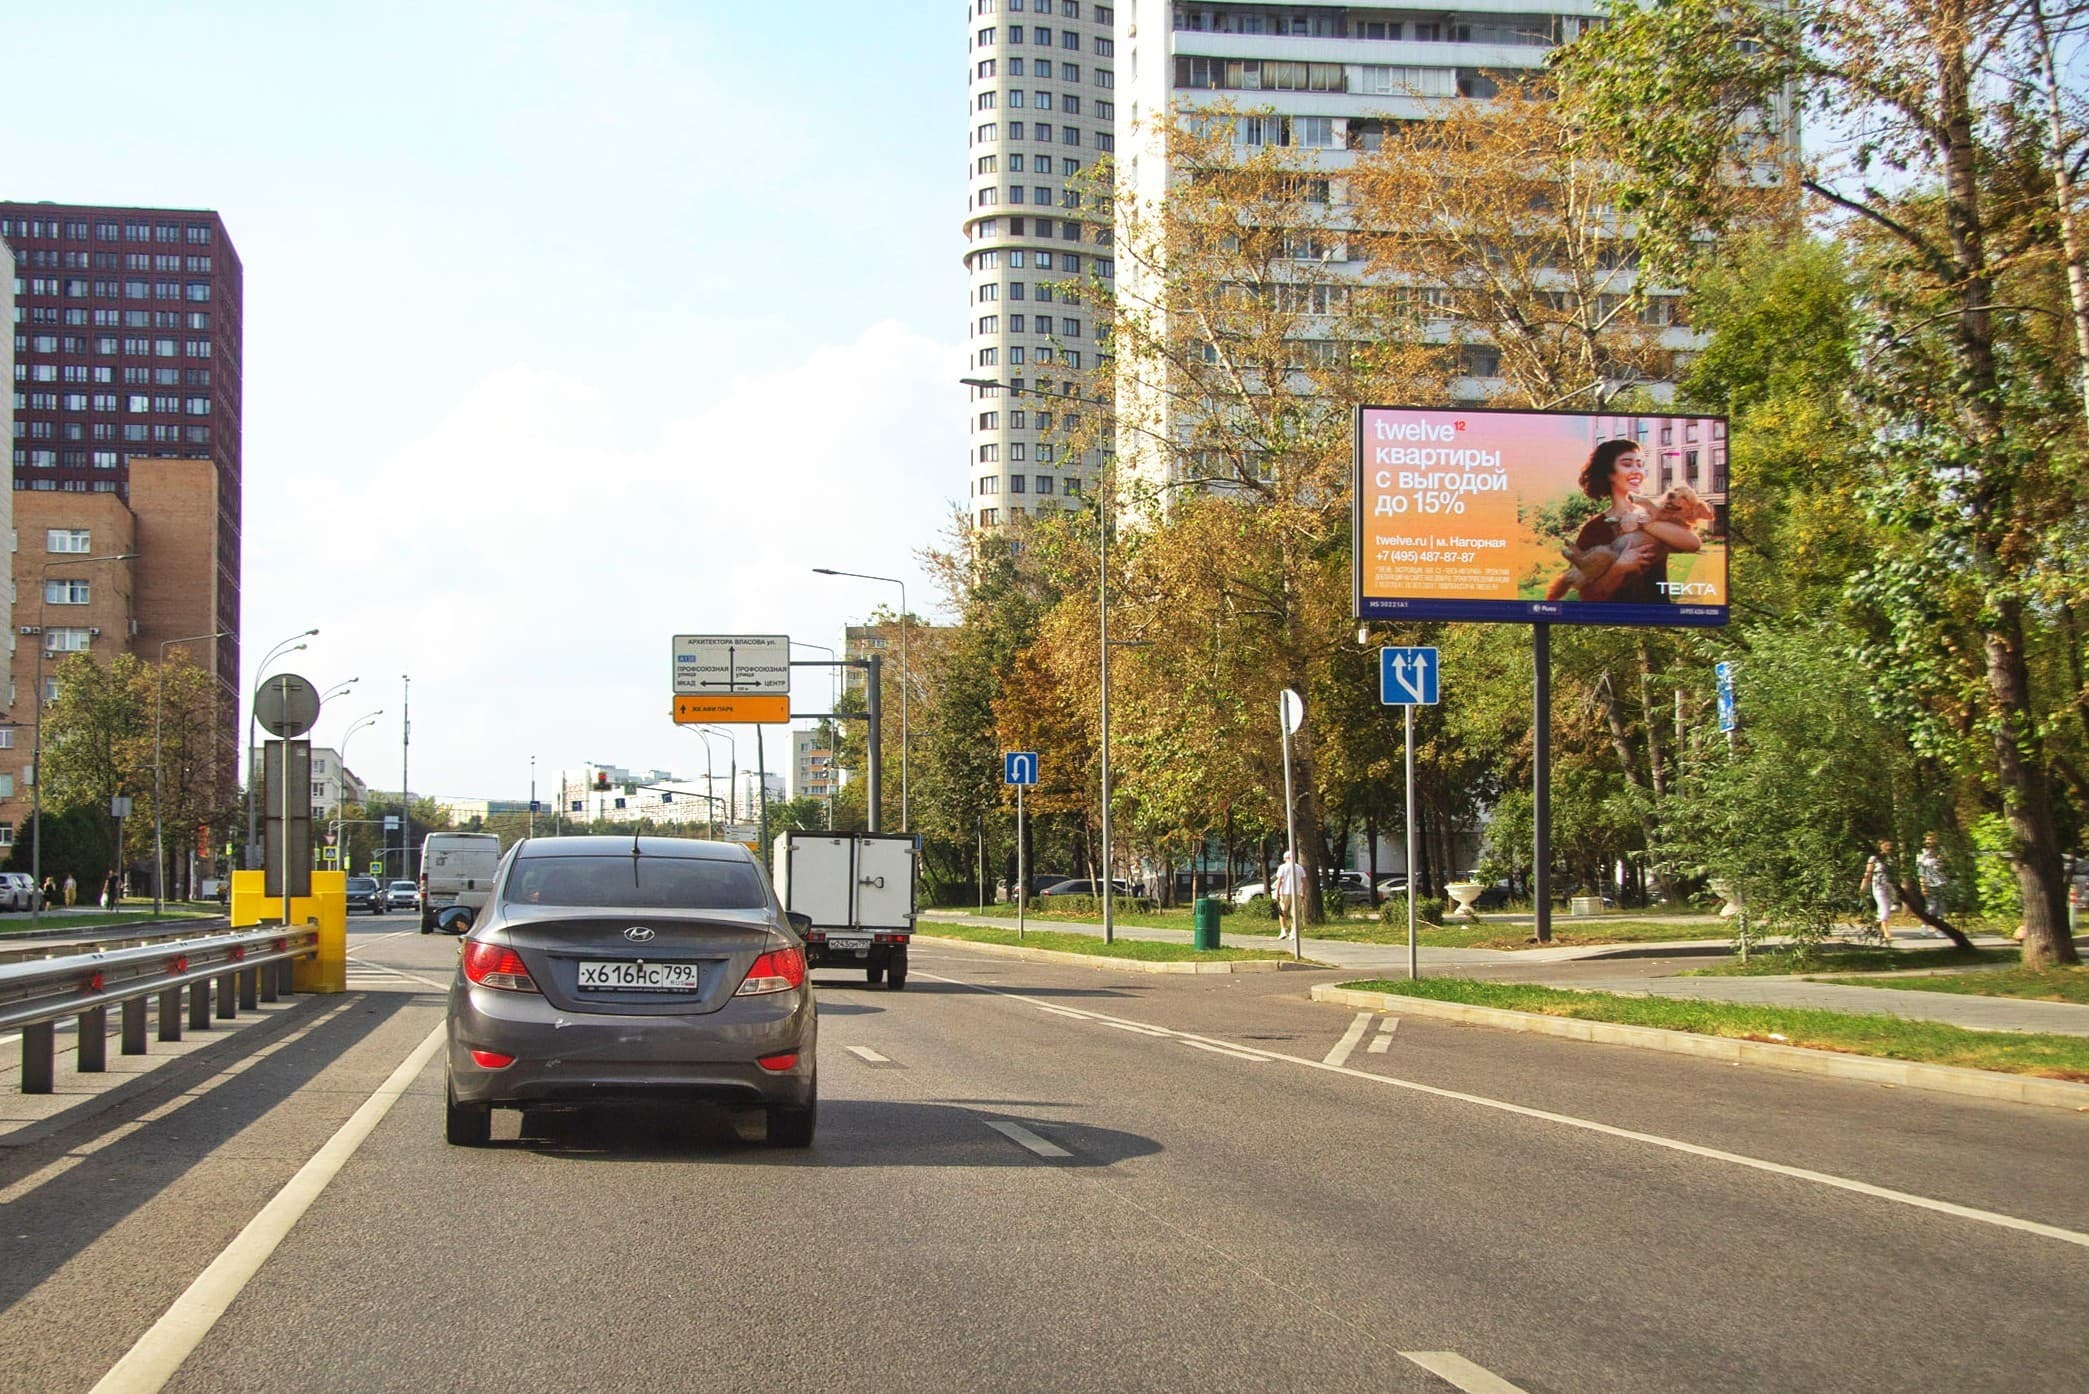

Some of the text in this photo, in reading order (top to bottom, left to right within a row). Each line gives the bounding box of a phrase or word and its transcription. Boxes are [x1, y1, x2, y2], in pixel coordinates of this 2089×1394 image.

[1375, 418, 1467, 441] twelve 12
[1375, 447, 1501, 470] квартиры
[1398, 467, 1508, 495] выгодой
[1374, 491, 1465, 517] до 15%
[1375, 535, 1427, 546] twelve.ru
[1449, 536, 1507, 549] Нагорная
[1375, 550, 1476, 563] +7 (495) 487-87-87
[764, 680, 786, 688] ЦЕНТР
[585, 965, 693, 984] Х616НС 799
